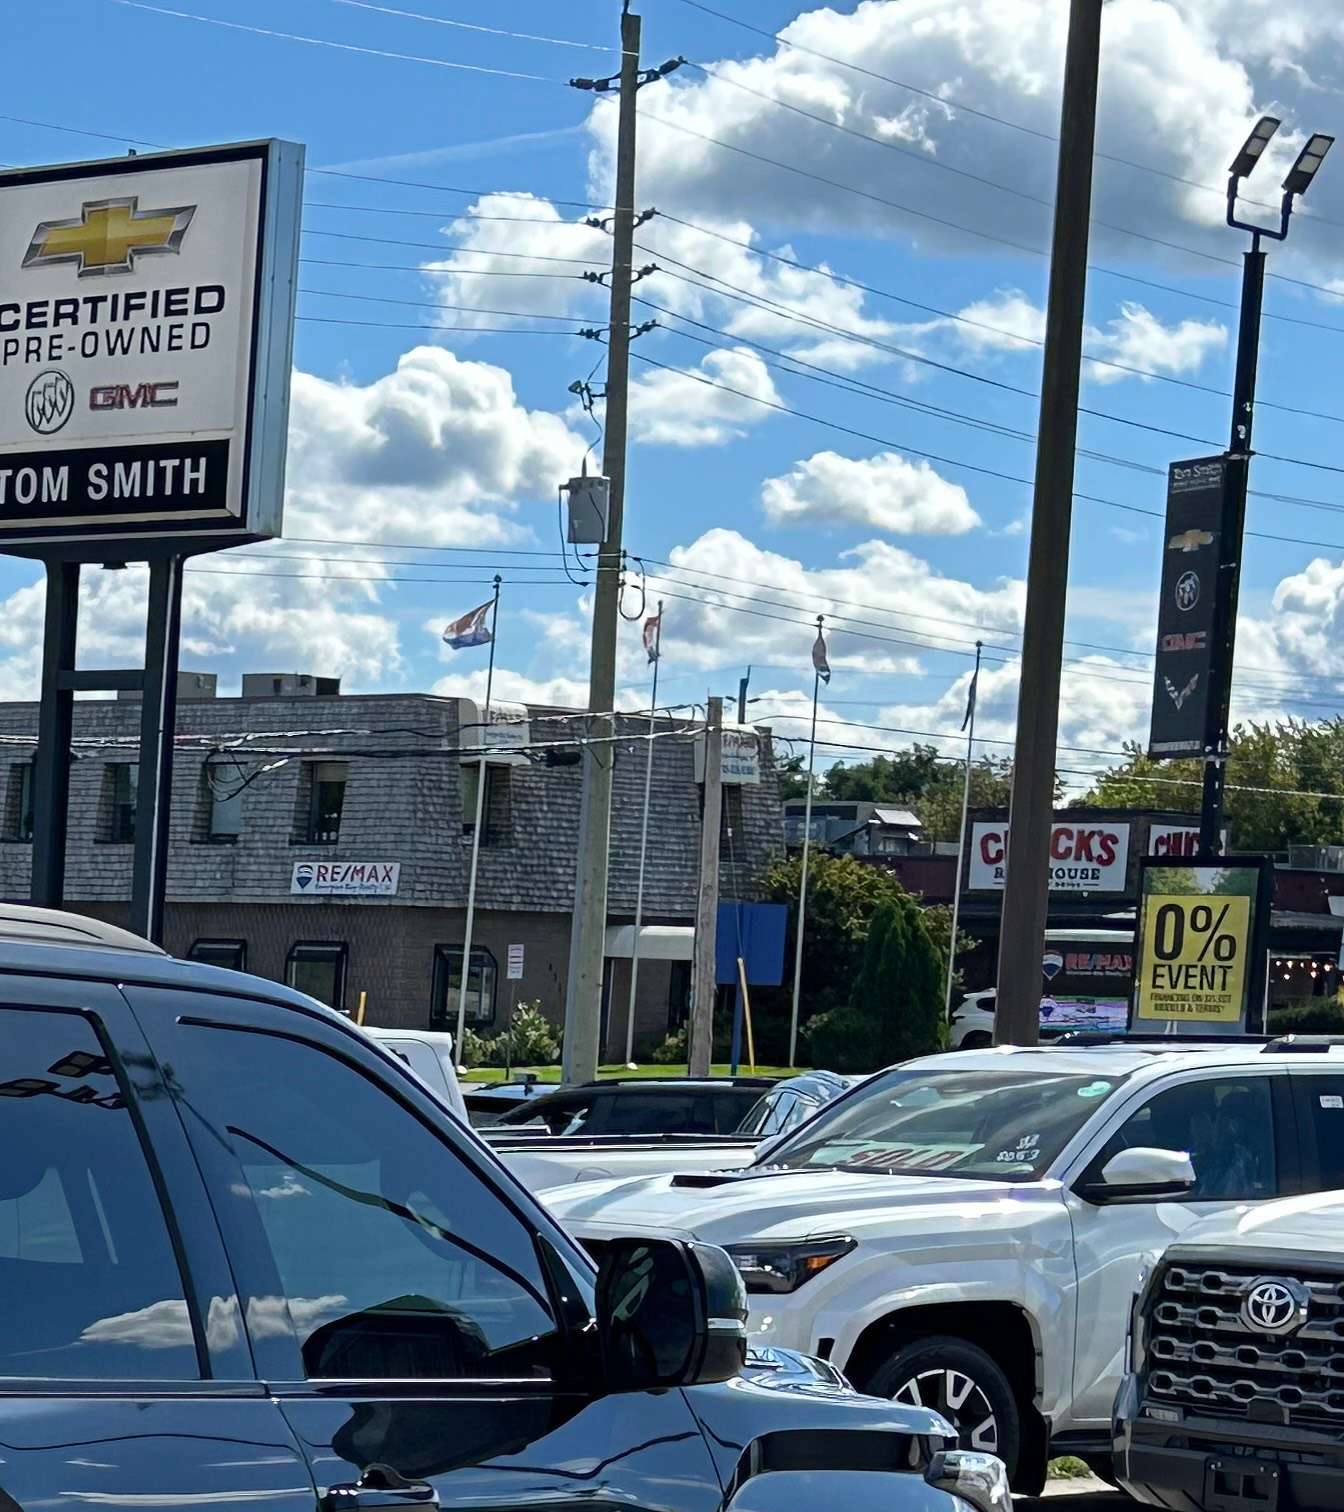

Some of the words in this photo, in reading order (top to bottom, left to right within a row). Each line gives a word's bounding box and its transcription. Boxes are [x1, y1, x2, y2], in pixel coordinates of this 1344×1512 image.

[3, 322, 211, 366] PRE-OWNED
[89, 380, 179, 411] GMC
[86, 456, 208, 500] SMITH
[980, 827, 1119, 867] CCK'S
[316, 864, 393, 883] RE/MAX
[1154, 903, 1237, 962] 0%
[1151, 963, 1233, 991] EVENT
